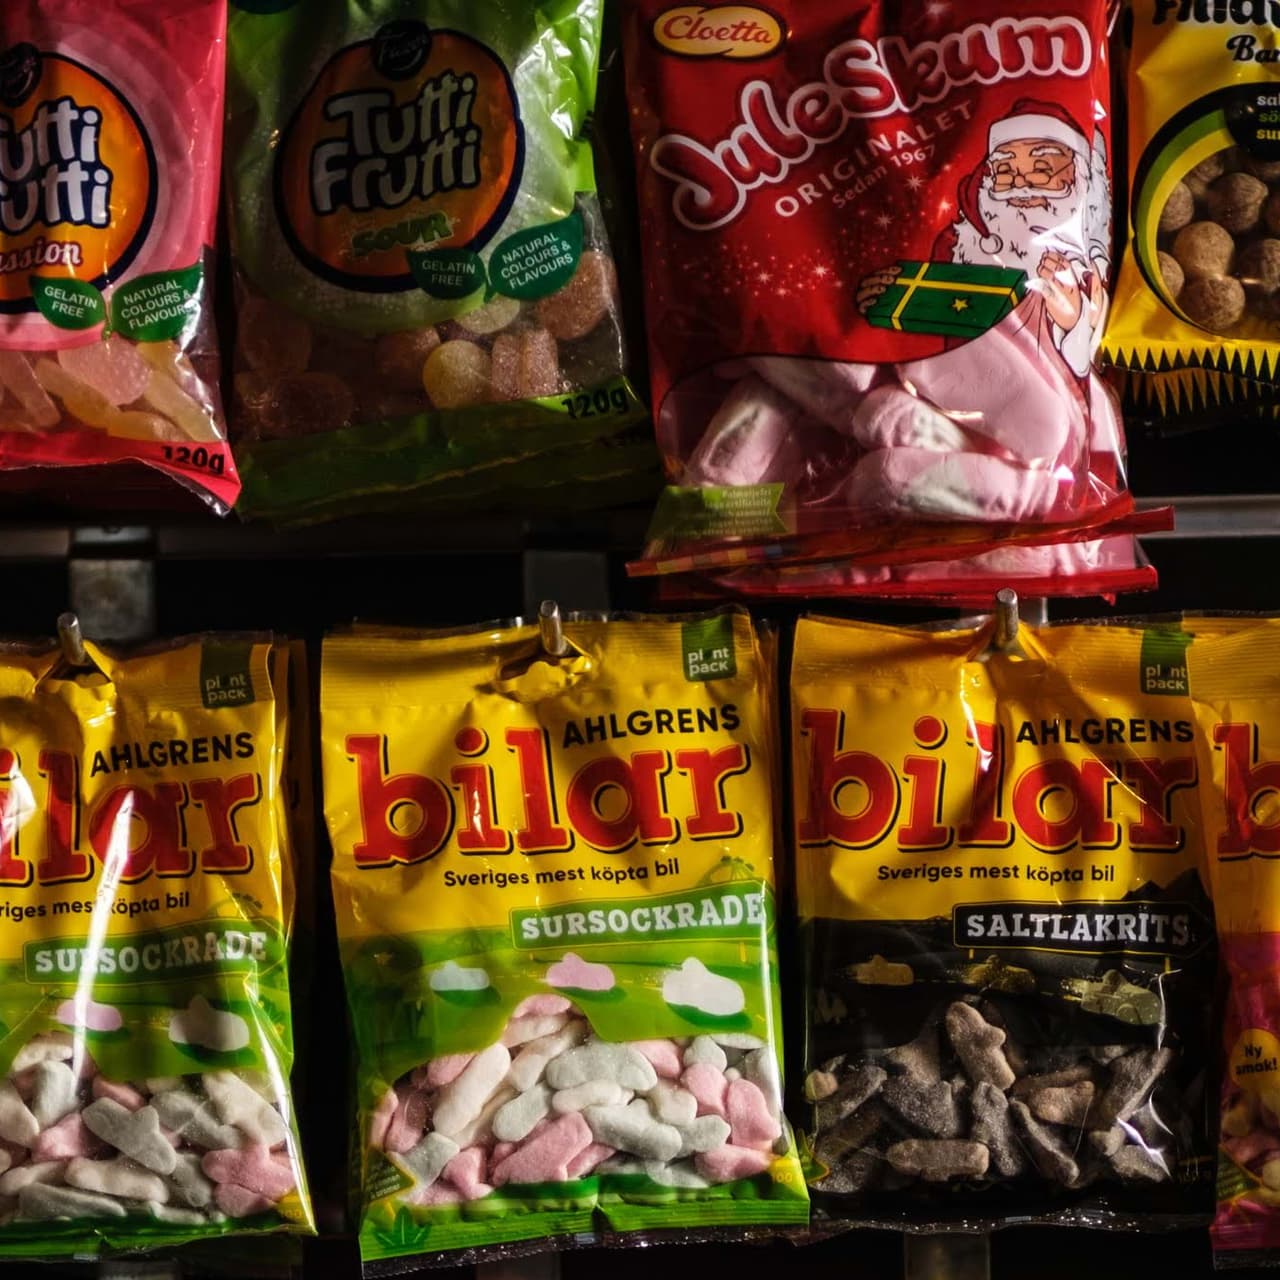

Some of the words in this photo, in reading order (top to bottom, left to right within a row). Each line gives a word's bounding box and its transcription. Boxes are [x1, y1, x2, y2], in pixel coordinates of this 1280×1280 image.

[662, 13, 773, 46] Cloetta
[326, 73, 475, 156] Tutti
[311, 128, 480, 213] Frutti
[774, 101, 975, 218] ORIGINALET
[833, 165, 888, 209] Sedan
[889, 144, 937, 168] 1967
[353, 213, 454, 256] SOUR
[501, 231, 558, 263] NATURAL
[422, 260, 475, 276] GELATIN
[500, 247, 558, 280] COLOURS
[509, 254, 573, 290] FLAVOURS
[123, 278, 182, 306] NATURAL
[431, 273, 463, 287] FREE
[44, 285, 98, 309] GELATIN
[52, 300, 84, 319] FREE
[121, 292, 179, 319] COLOURS
[562, 390, 629, 419] 120g
[161, 446, 224, 474] 120g
[689, 660, 729, 677] pack
[1146, 677, 1186, 692] pack
[563, 703, 741, 749] AHLGRENS
[1016, 719, 1195, 745] AHLGRENS
[90, 732, 255, 777] AHLGRENS
[799, 707, 1199, 855] bilar
[345, 726, 752, 870] bilar
[444, 870, 529, 888] Sveriges
[535, 866, 585, 884] mest
[591, 863, 648, 885] köpta
[655, 858, 680, 877] bil
[877, 864, 963, 882] Sveriges
[970, 866, 1019, 879] mest
[1026, 865, 1084, 886] köpta
[1091, 865, 1115, 882] bil
[166, 892, 190, 909] bil
[521, 893, 764, 940] SURSOCKRADE
[967, 912, 1189, 946] SALTLAKRITS
[1235, 1058, 1278, 1075] smak!
